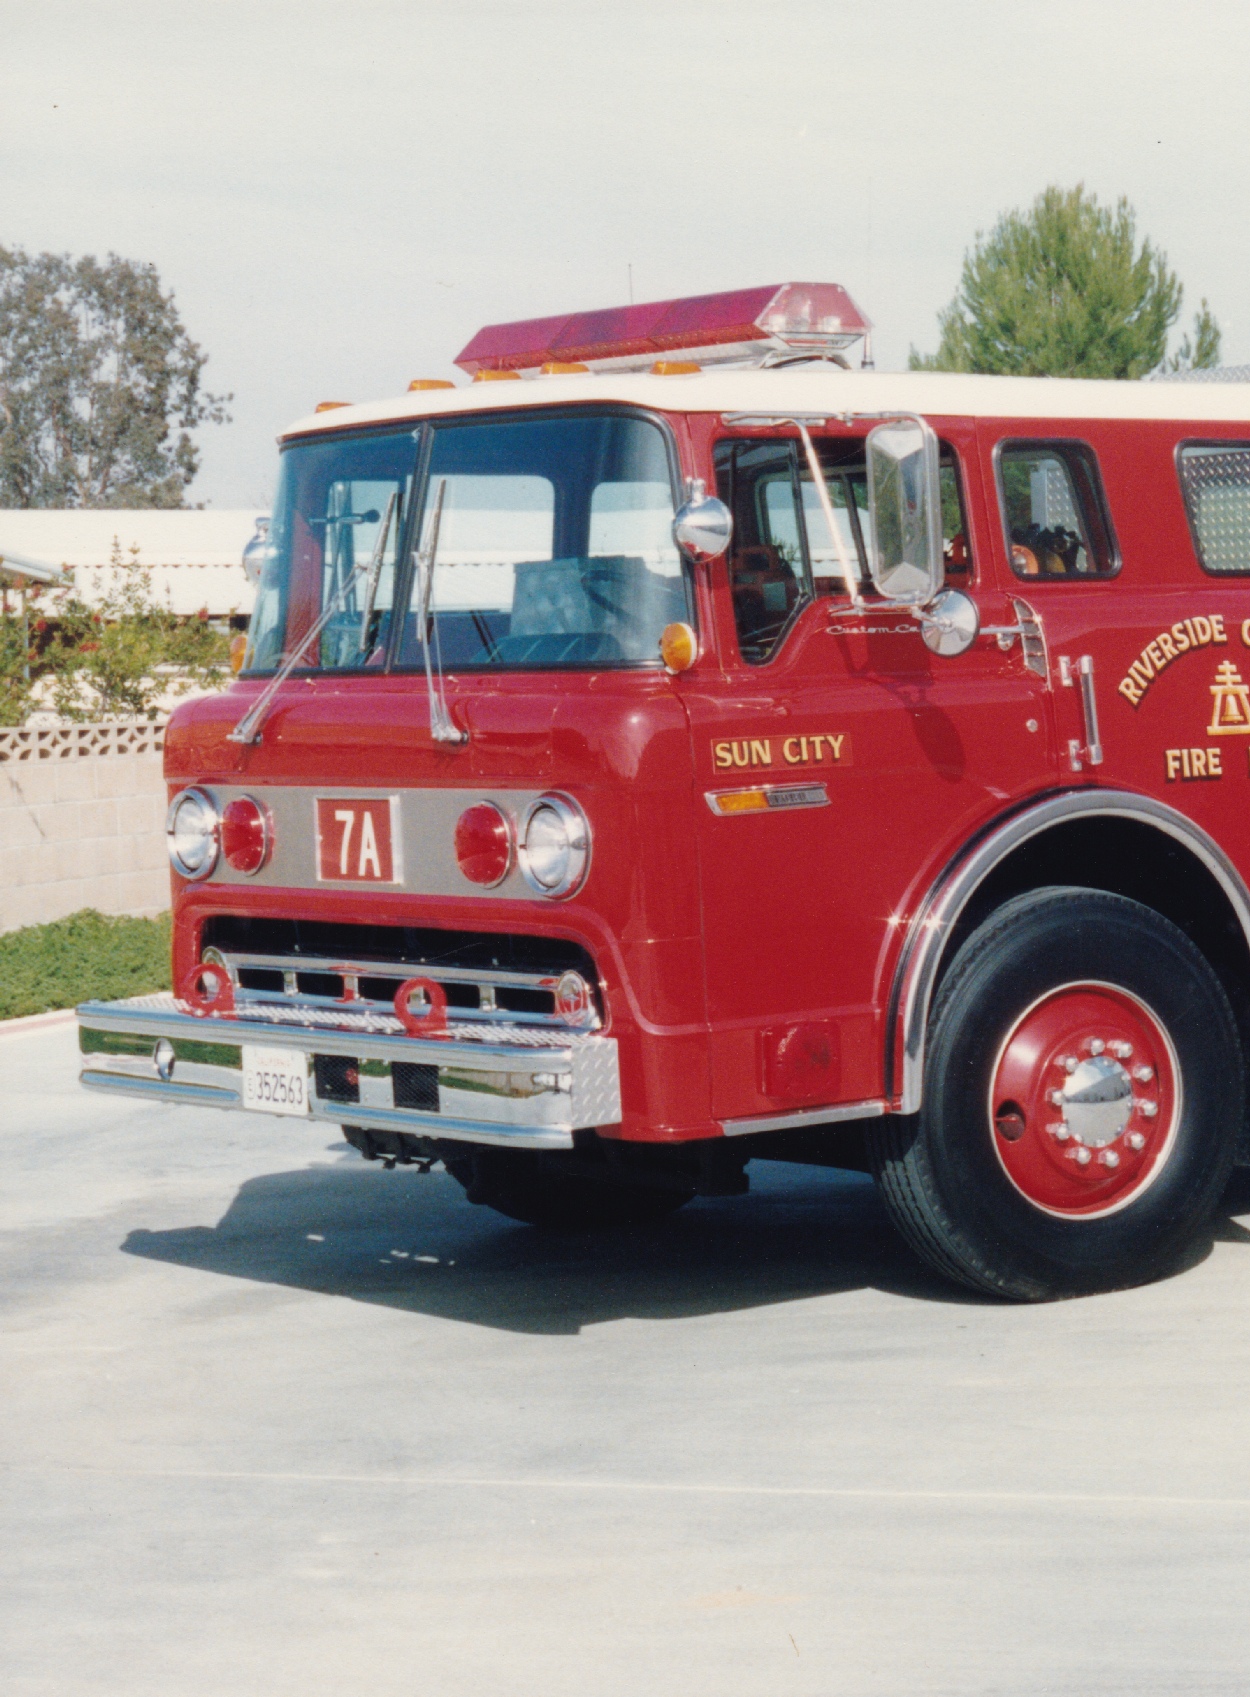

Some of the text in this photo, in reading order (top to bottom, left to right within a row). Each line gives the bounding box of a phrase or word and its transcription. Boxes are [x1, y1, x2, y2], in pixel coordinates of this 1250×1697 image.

[825, 623, 921, 635] Custom Ca
[1117, 614, 1228, 707] RIVERSIDE
[715, 734, 845, 768] SUN CITY
[1165, 747, 1223, 780] FIRE
[334, 810, 382, 877] 7A
[256, 1070, 303, 1105] 352563
